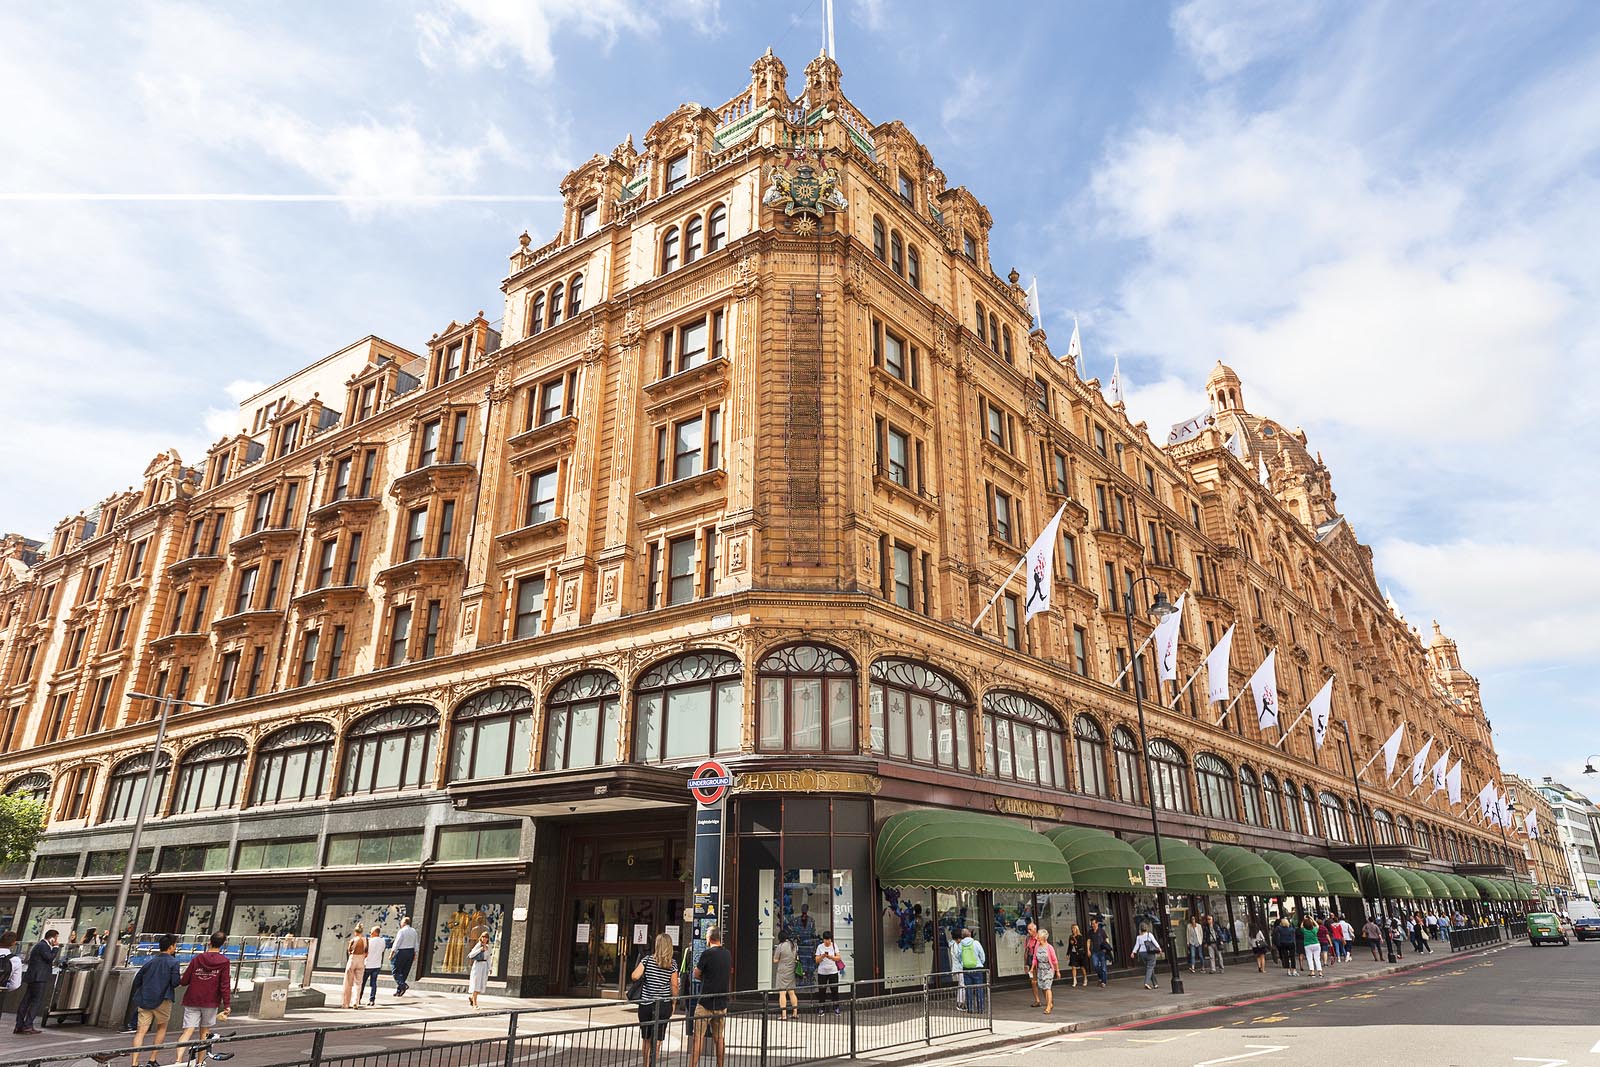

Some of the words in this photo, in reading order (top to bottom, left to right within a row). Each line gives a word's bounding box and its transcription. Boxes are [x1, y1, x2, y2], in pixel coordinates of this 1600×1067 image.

[690, 778, 729, 787] UNDERGROUND
[748, 773, 840, 790] HARRODS
[627, 855, 634, 866] 6
[1013, 861, 1035, 882] Harrods
